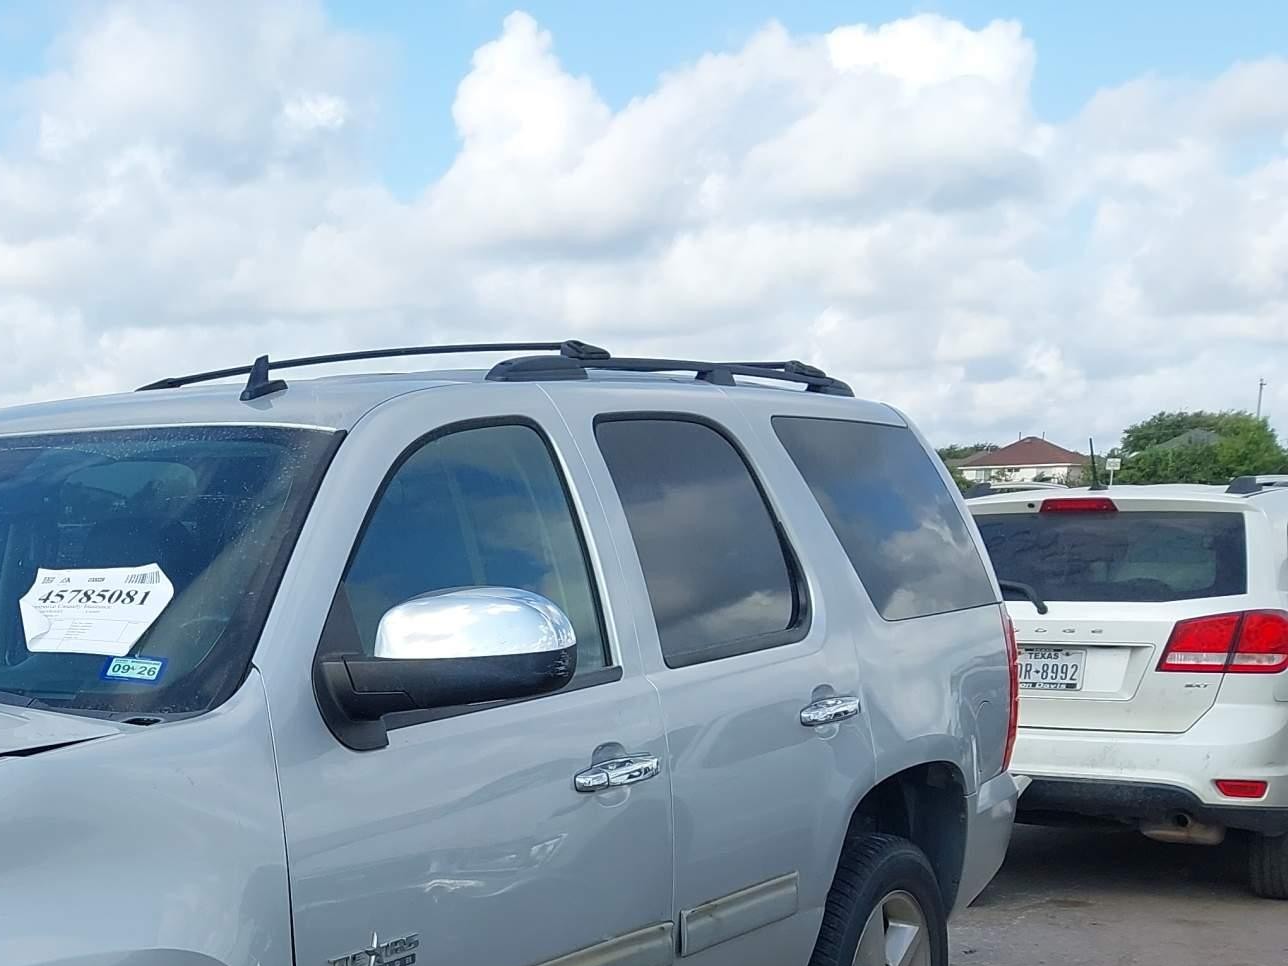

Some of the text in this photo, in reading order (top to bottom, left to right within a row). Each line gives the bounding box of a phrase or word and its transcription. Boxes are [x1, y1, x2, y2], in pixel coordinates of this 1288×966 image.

[38, 589, 151, 605] 45785081
[1028, 652, 1060, 660] TEXAS
[112, 663, 158, 676] 09 26
